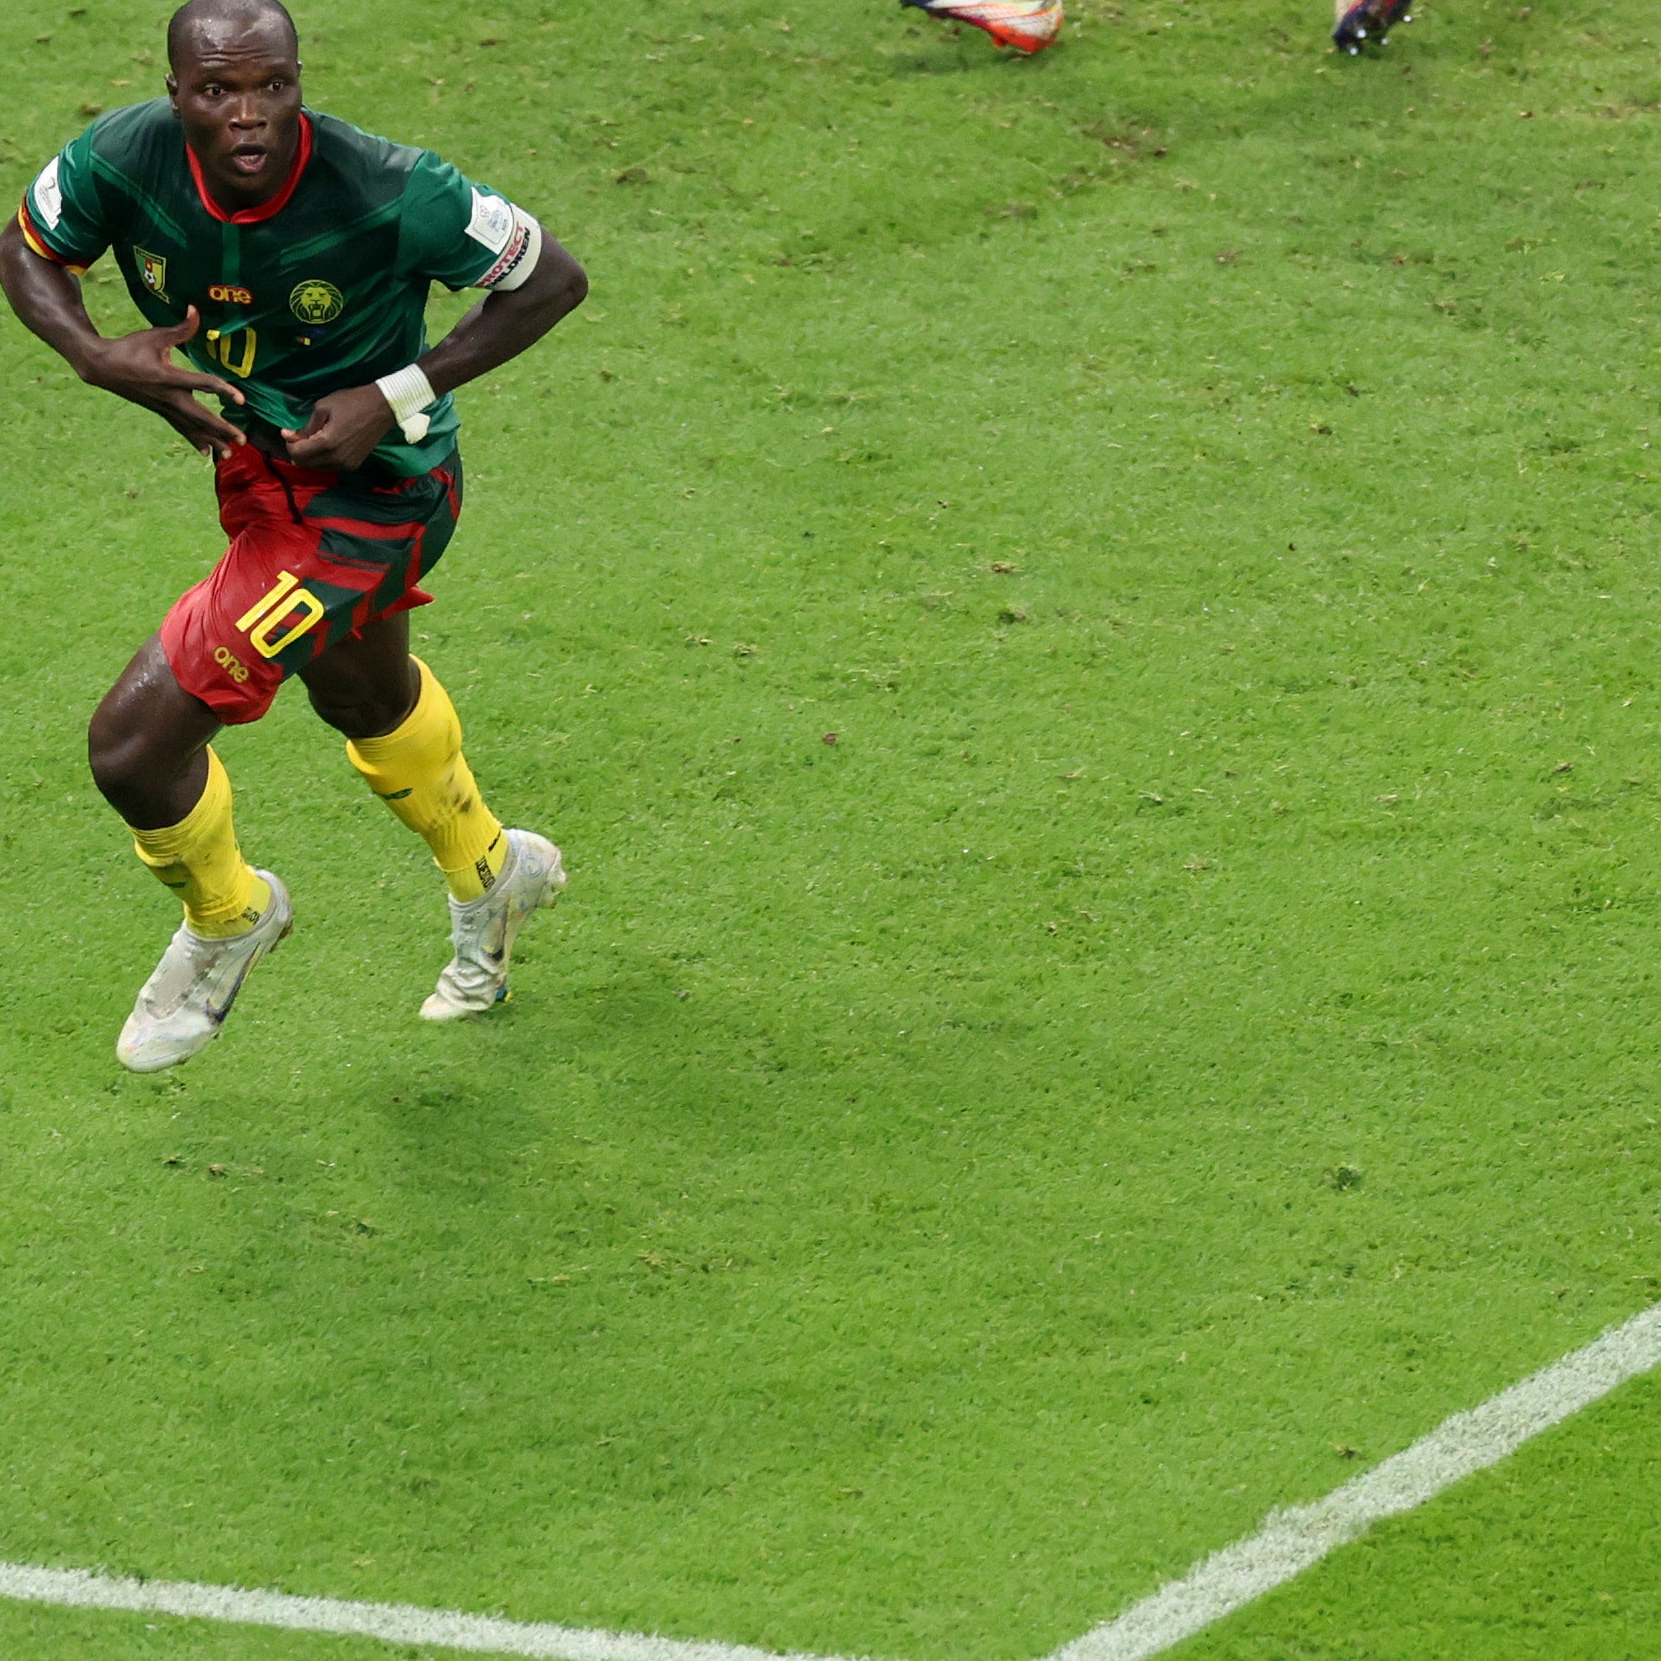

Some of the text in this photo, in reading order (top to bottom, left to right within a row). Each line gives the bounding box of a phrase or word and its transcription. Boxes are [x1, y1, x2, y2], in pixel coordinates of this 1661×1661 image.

[208, 285, 254, 305] one
[234, 570, 325, 659] 10
[213, 646, 249, 683] one
